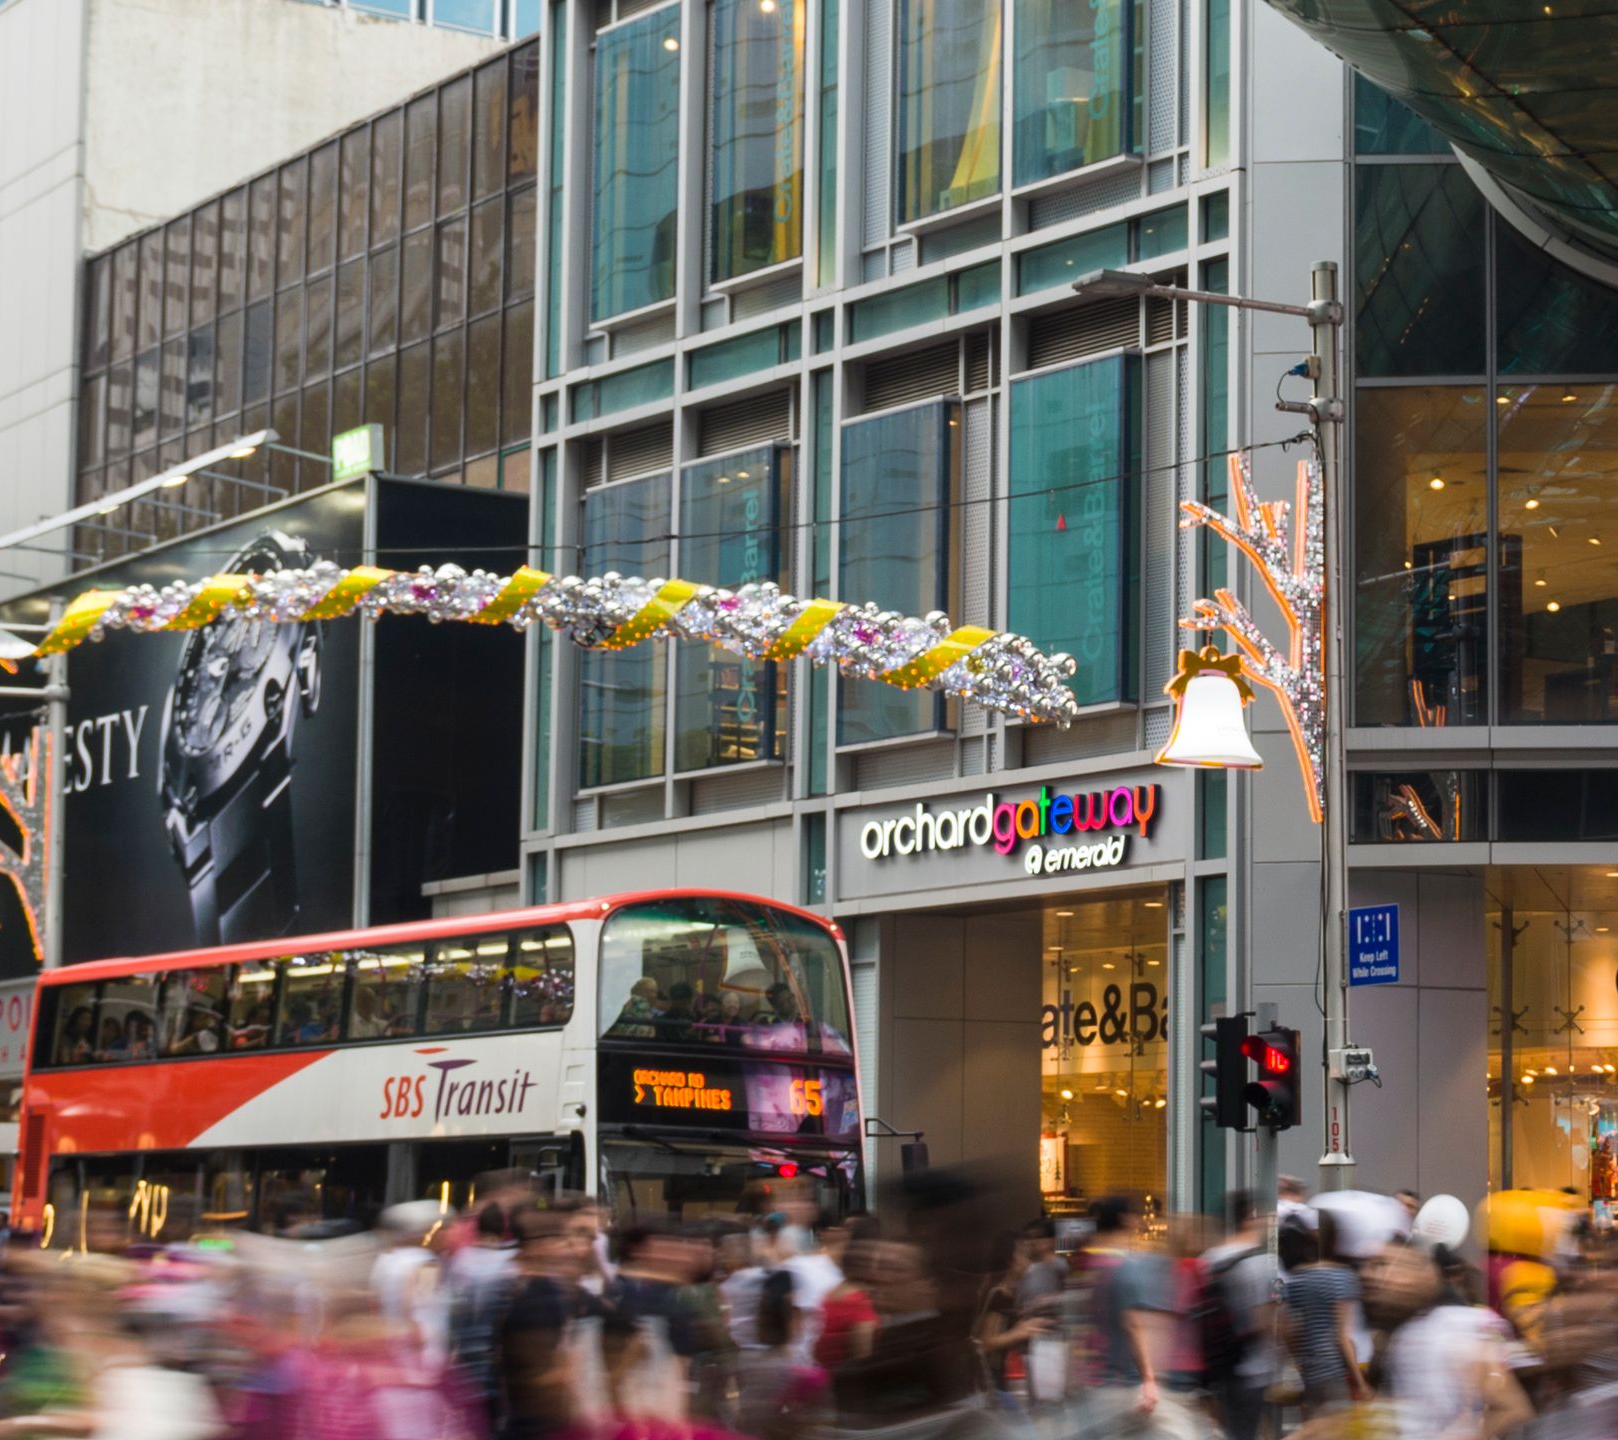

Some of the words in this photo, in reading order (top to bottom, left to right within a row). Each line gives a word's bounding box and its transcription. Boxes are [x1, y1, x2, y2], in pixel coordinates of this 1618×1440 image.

[860, 783, 1158, 856] orchardgateway
[1024, 844, 1043, 874] @
[1044, 834, 1126, 873] emerald
[1352, 966, 1369, 979] While
[1370, 966, 1397, 978] Crossing
[1359, 952, 1375, 964] Keep
[1376, 949, 1389, 961] Left
[379, 1073, 427, 1121] SBS
[427, 1058, 539, 1124] Transit
[633, 1069, 686, 1088] ORCHARD
[688, 1072, 705, 1089] RD
[653, 1086, 732, 1111] TAMPINES
[789, 1079, 824, 1116] 65
[1331, 1106, 1340, 1153] 105
